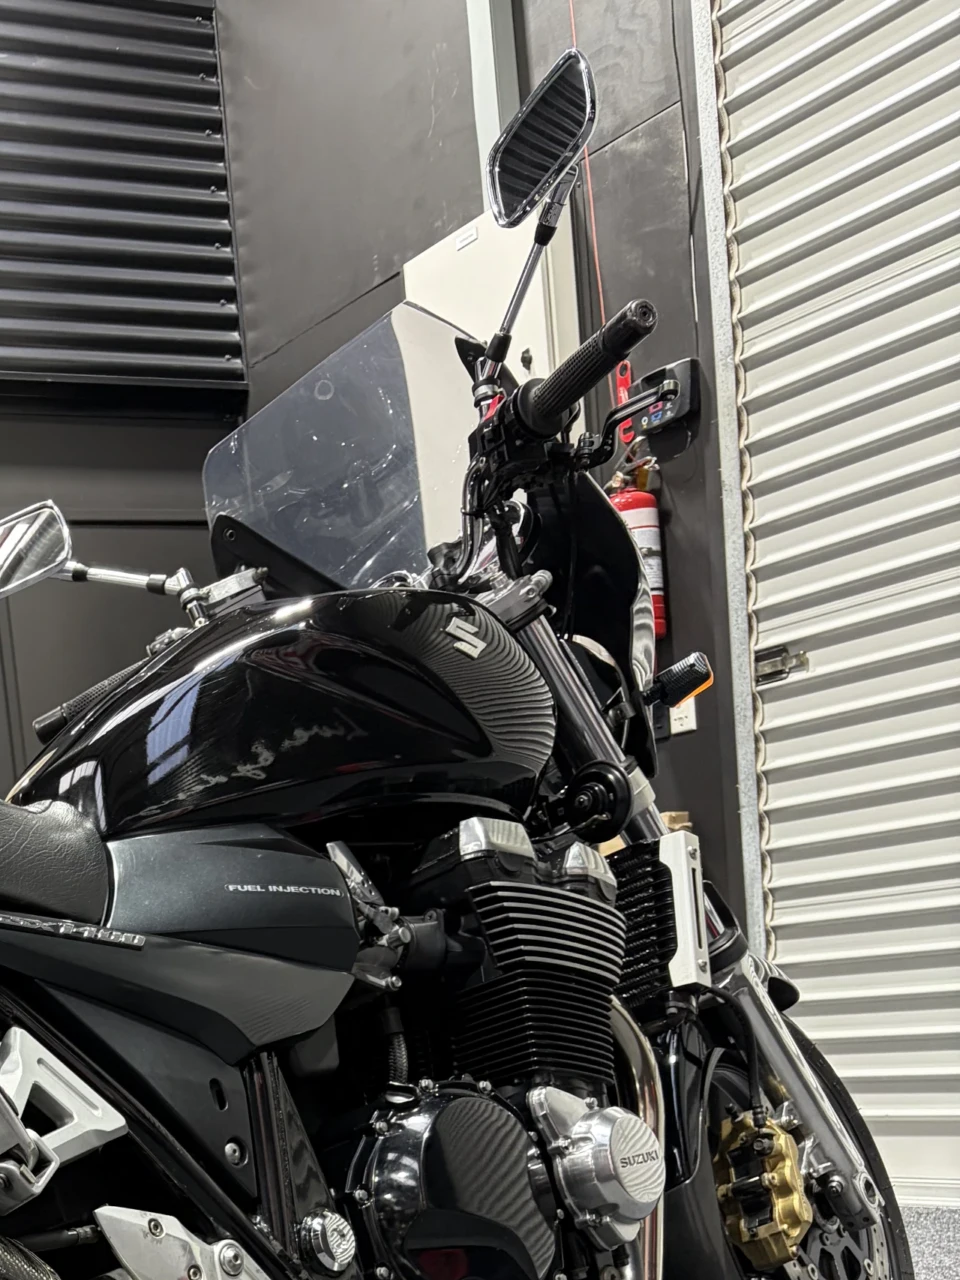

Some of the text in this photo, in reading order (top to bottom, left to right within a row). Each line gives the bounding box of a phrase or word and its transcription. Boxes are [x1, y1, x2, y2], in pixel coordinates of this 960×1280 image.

[228, 884, 341, 896] FUEL INJECTION
[620, 1149, 659, 1168] SUZUKI
